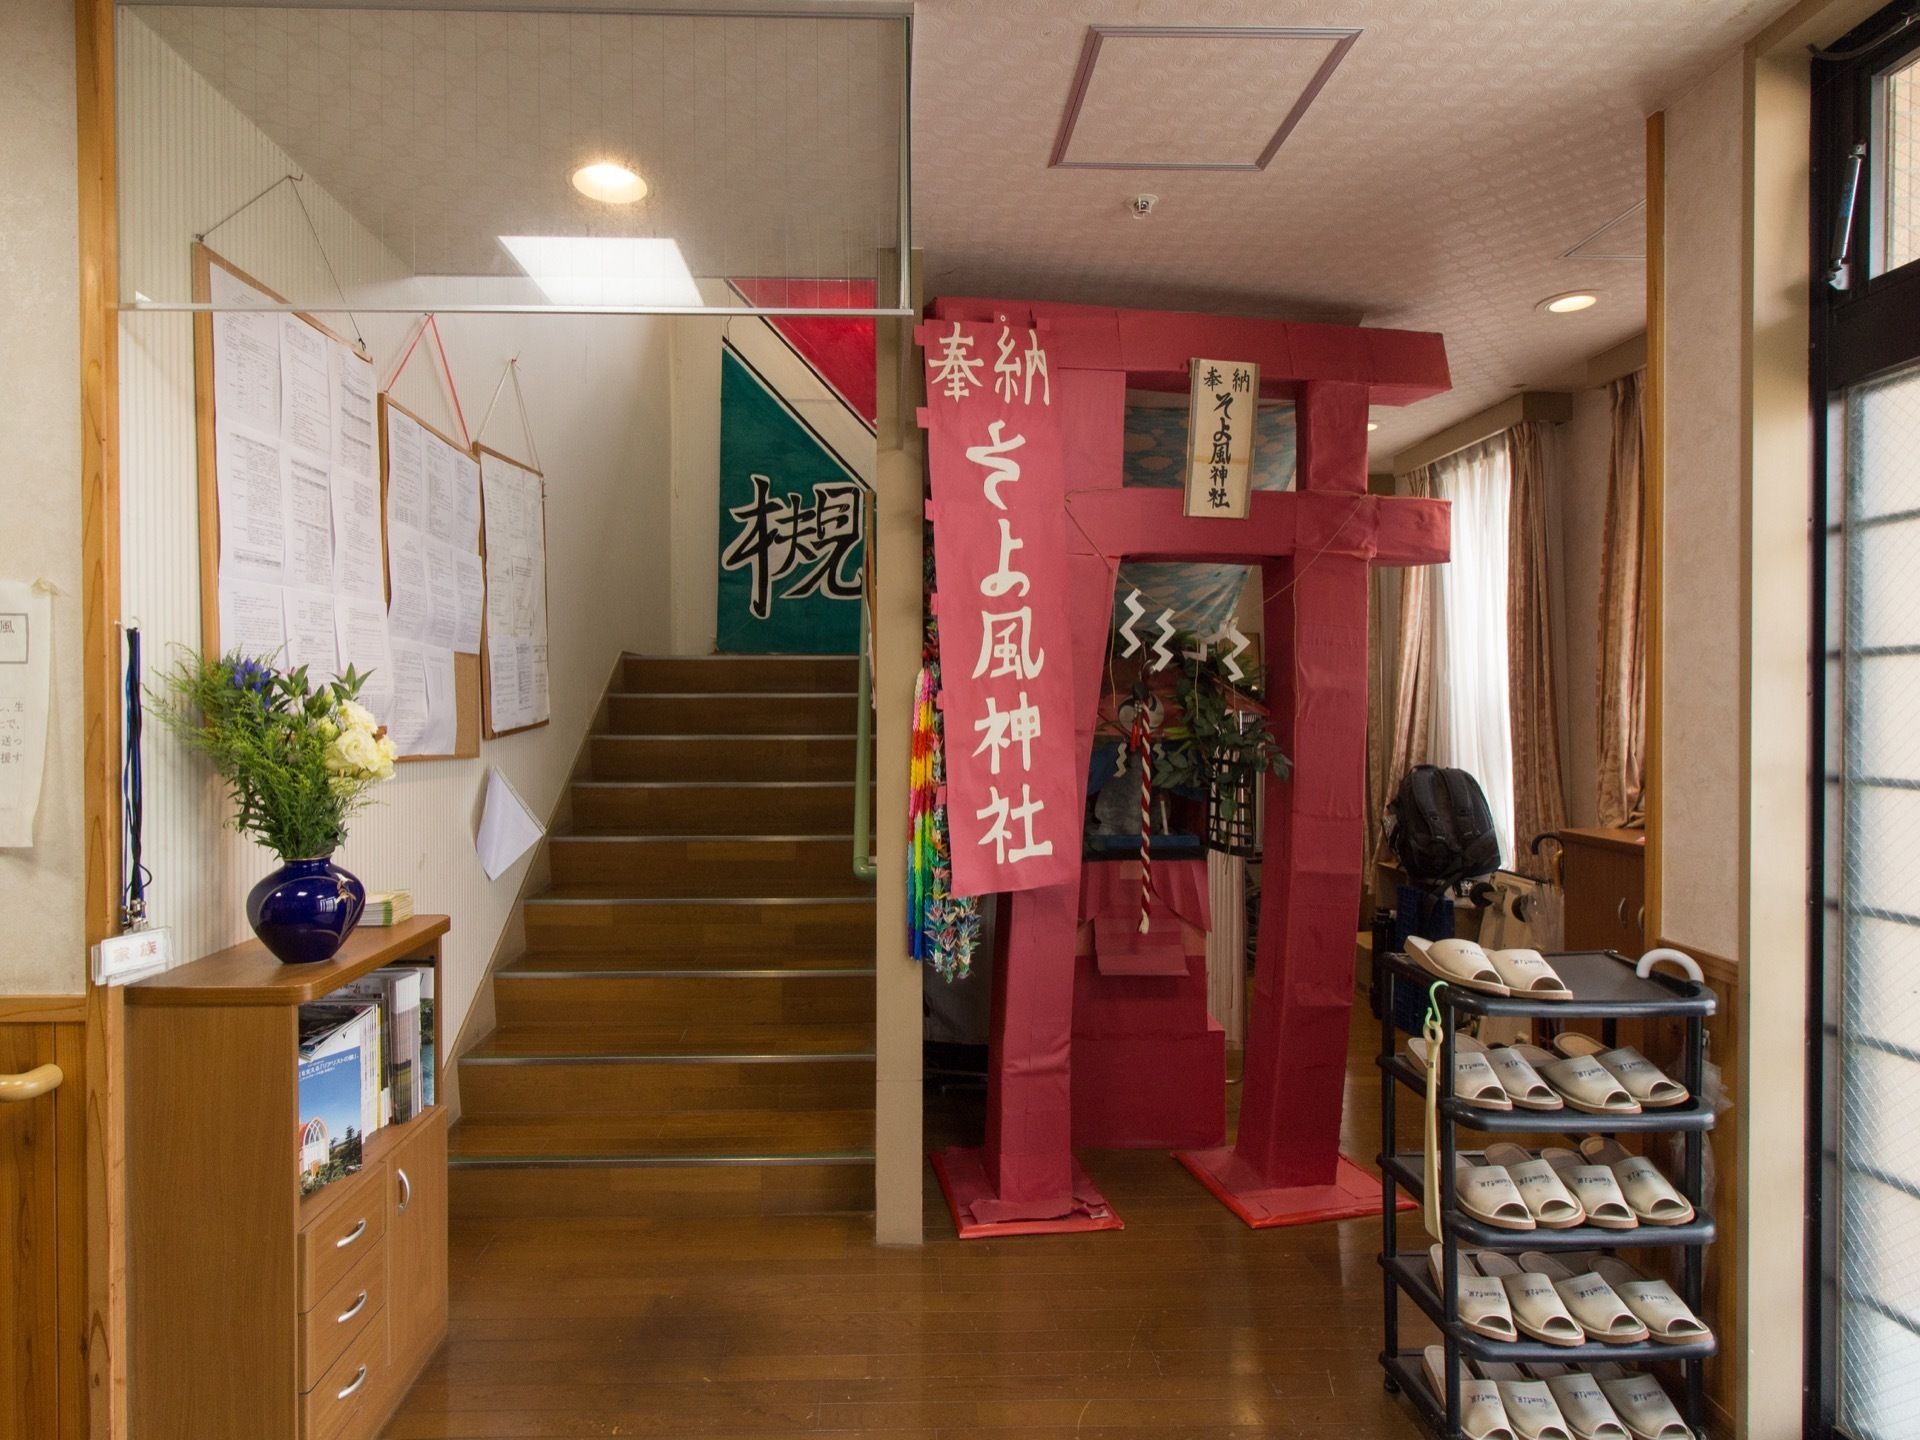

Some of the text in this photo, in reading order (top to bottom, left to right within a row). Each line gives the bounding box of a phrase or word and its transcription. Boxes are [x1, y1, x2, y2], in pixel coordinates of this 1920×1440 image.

[928, 318, 1050, 407] 奉納
[1203, 366, 1251, 393] 奉納
[1207, 392, 1234, 510] そよ風神社
[965, 419, 1053, 865] そよ風神社
